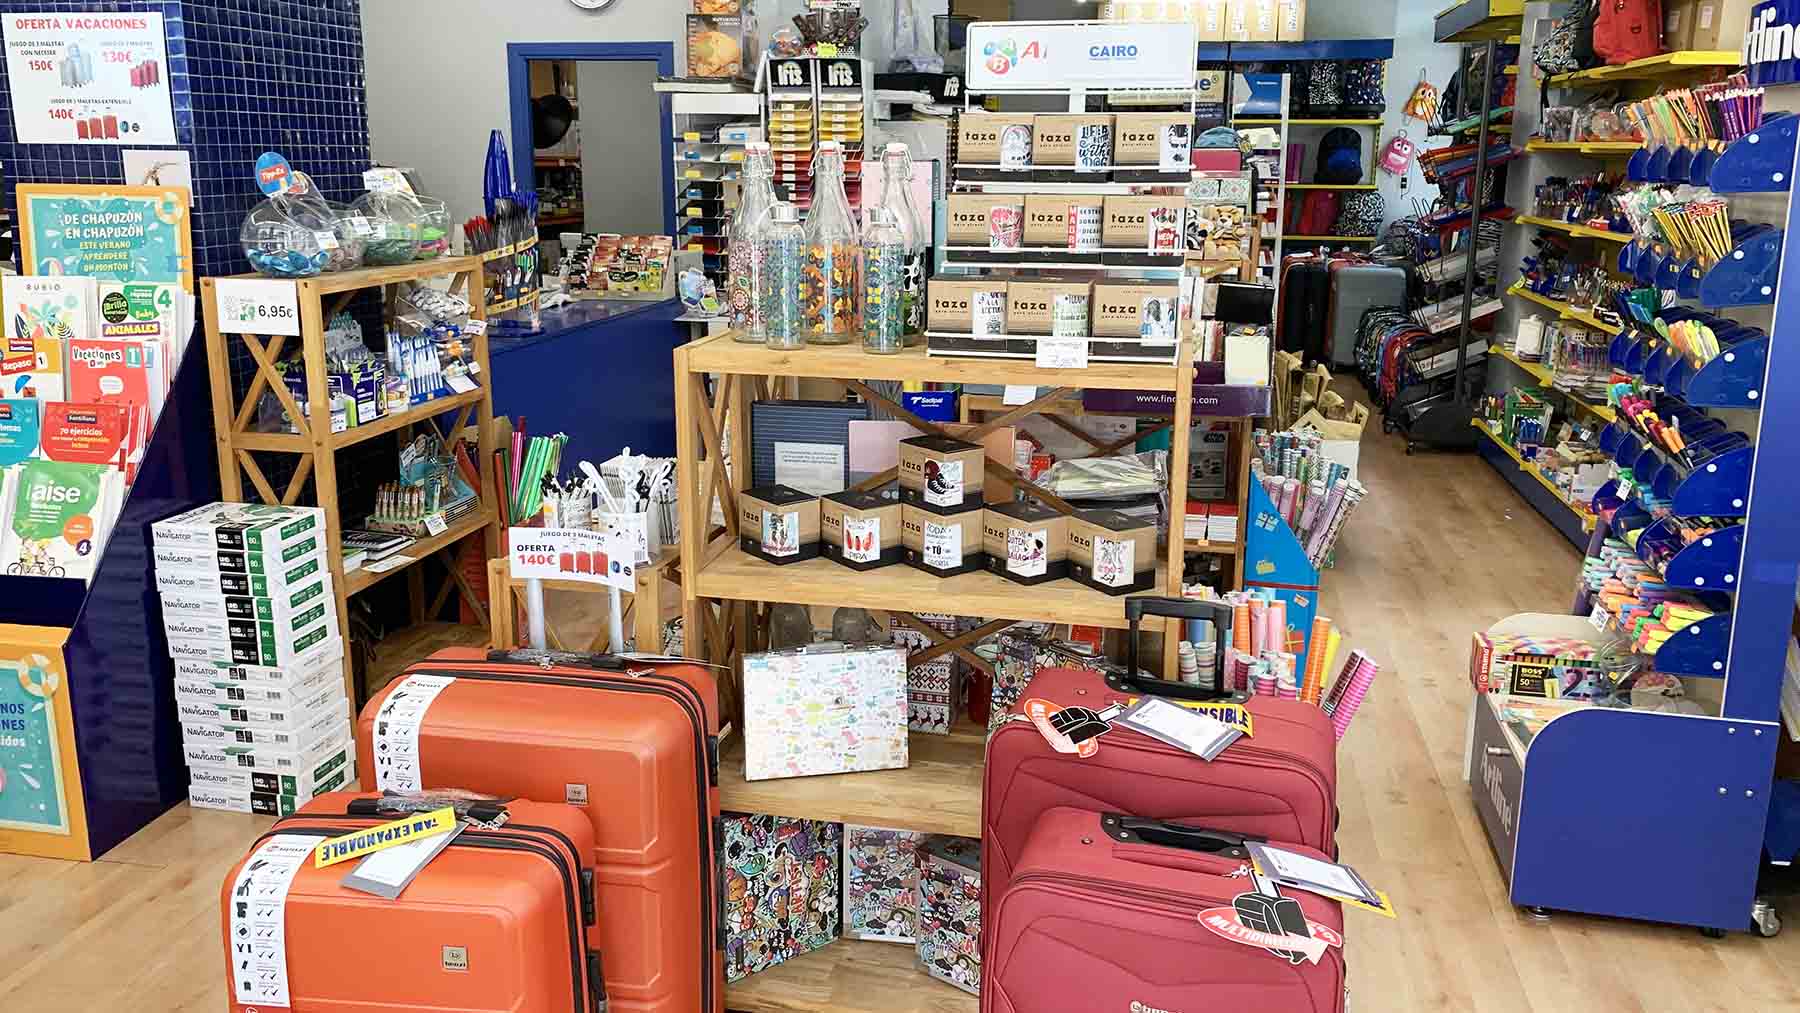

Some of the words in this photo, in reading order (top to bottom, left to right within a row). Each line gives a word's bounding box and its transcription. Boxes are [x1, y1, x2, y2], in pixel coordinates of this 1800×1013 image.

[15, 18, 62, 30] OFERTA
[66, 18, 147, 30] VACACIONES
[1089, 45, 1138, 56] CAIRO
[29, 60, 54, 70] 150€
[49, 109, 74, 120] 140€
[965, 132, 996, 141] taza
[1040, 134, 1071, 142] taza
[1122, 132, 1155, 142] taza
[82, 209, 144, 224] CHAPUZÓN
[954, 212, 985, 222] taza
[1031, 212, 1064, 222] taza
[1112, 214, 1144, 223] taza
[65, 228, 80, 239] EN
[84, 224, 144, 238] CHAPUZÓN
[99, 240, 130, 249] VERANO
[158, 289, 172, 308] 4
[936, 300, 968, 309] taza
[1014, 301, 1047, 310] taza
[1102, 304, 1136, 314] taza
[258, 305, 293, 318] 6,95€
[105, 324, 158, 335] ANIMALES
[73, 348, 120, 360] Vacaciones
[2, 360, 32, 370] Repaso
[38, 357, 43, 365] 1
[70, 427, 102, 436] ejercicios
[902, 459, 921, 472] taza
[744, 510, 759, 522] taza
[823, 514, 840, 527] taza
[902, 520, 921, 532] taza
[156, 532, 191, 540] NAVIGATOR
[578, 532, 605, 542] MALETAS
[984, 526, 1004, 539] taza
[1070, 532, 1090, 547] taza
[80, 544, 88, 552] 4
[516, 544, 556, 552] OFERTA
[932, 545, 942, 555] TÚ
[158, 554, 192, 563] NAVIGATOR
[518, 554, 556, 566] 140€
[159, 578, 194, 586] NAVIGATOR
[164, 600, 200, 610] NAVIGATOR
[168, 624, 204, 634] NAVIGATOR
[172, 646, 208, 656] NAVIGATOR
[180, 666, 218, 676] NAVIGATOR
[178, 686, 216, 696] NAVIGATOR
[182, 707, 220, 717] NAVIGATOR
[186, 728, 224, 738] NAVIGATOR
[188, 752, 226, 762] NAVIGATOR
[193, 773, 228, 782] NAVIGATOR
[192, 795, 227, 804] NAVIGATOR
[322, 824, 411, 862] EXPANDABLE
